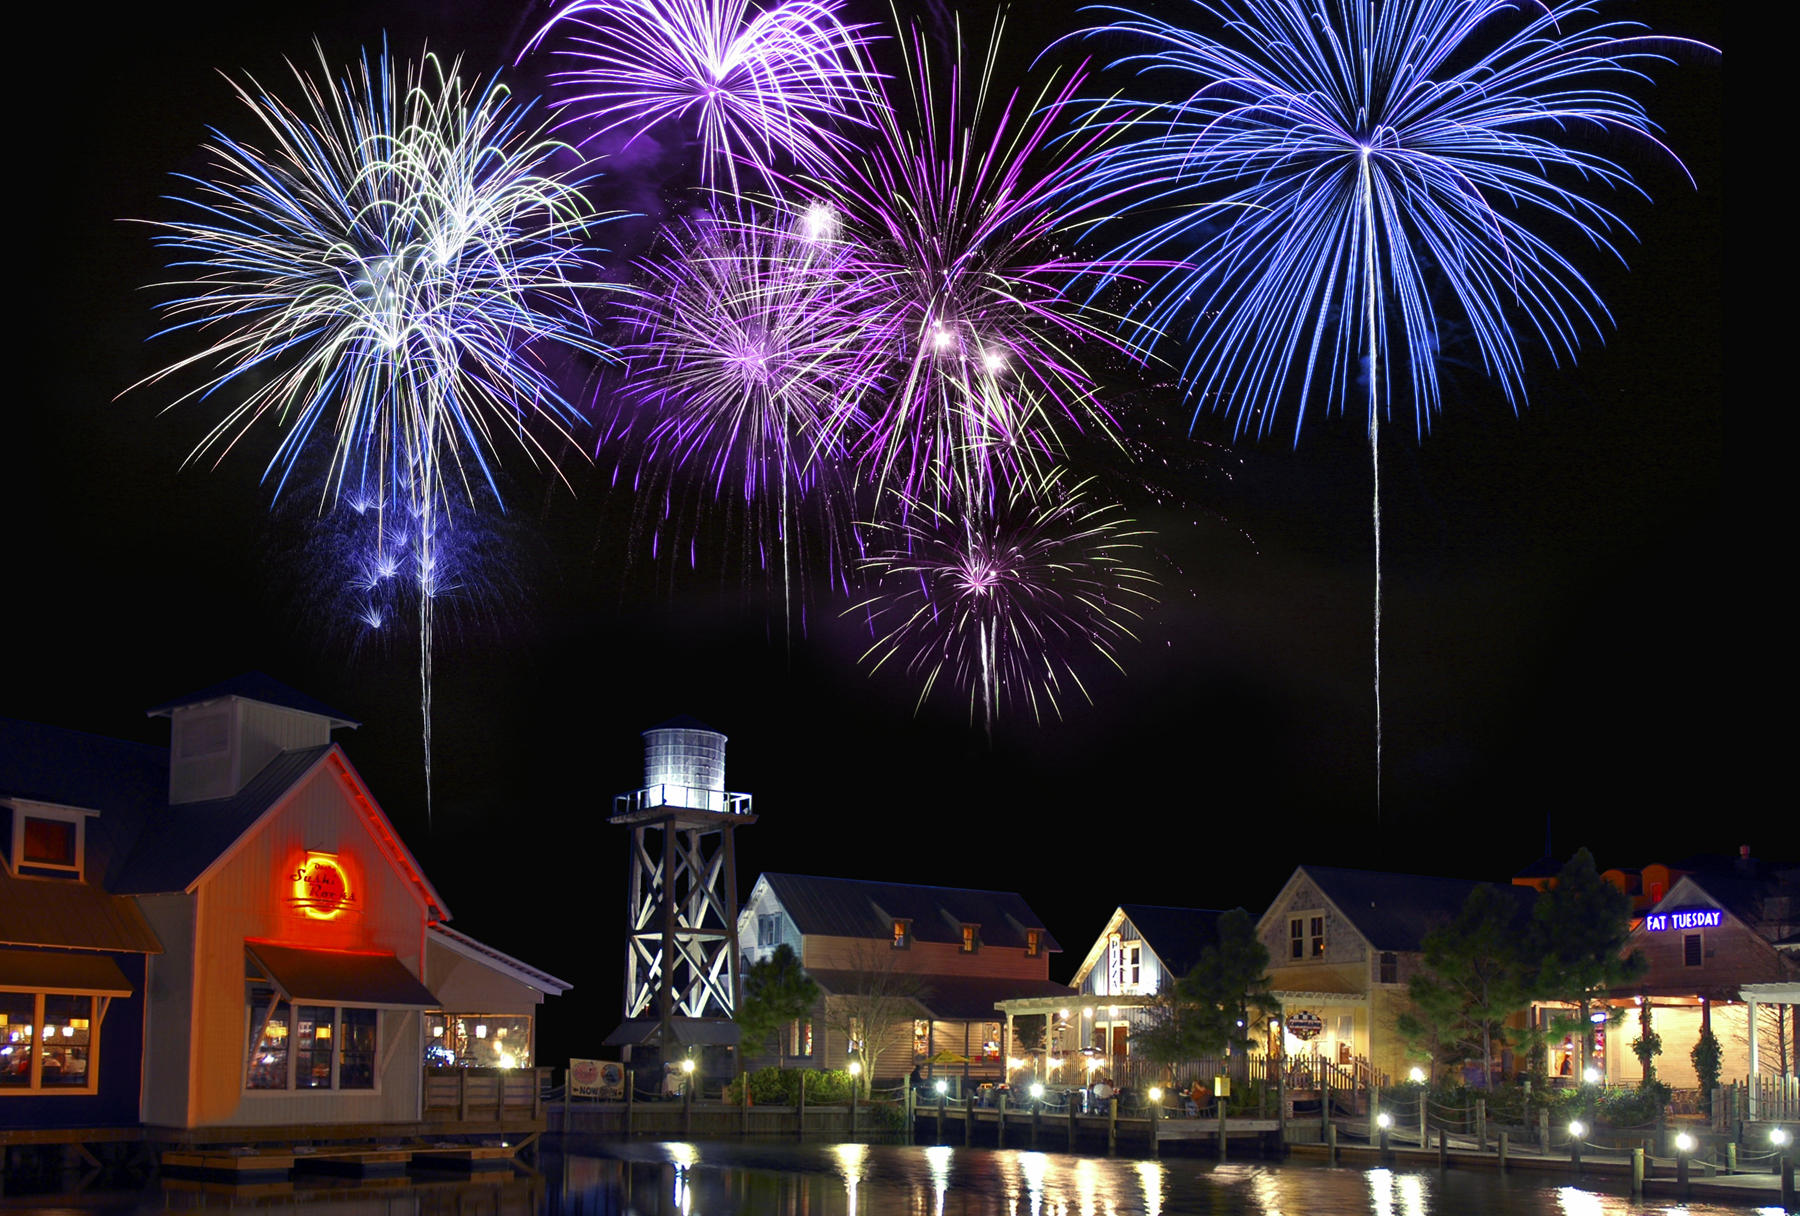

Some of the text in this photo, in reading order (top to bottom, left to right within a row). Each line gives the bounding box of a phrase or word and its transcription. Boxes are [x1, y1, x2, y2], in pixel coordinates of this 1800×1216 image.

[289, 868, 336, 885] Sushi
[1646, 912, 1720, 931] FAT TUESDAY
[579, 1086, 599, 1095] NOW
